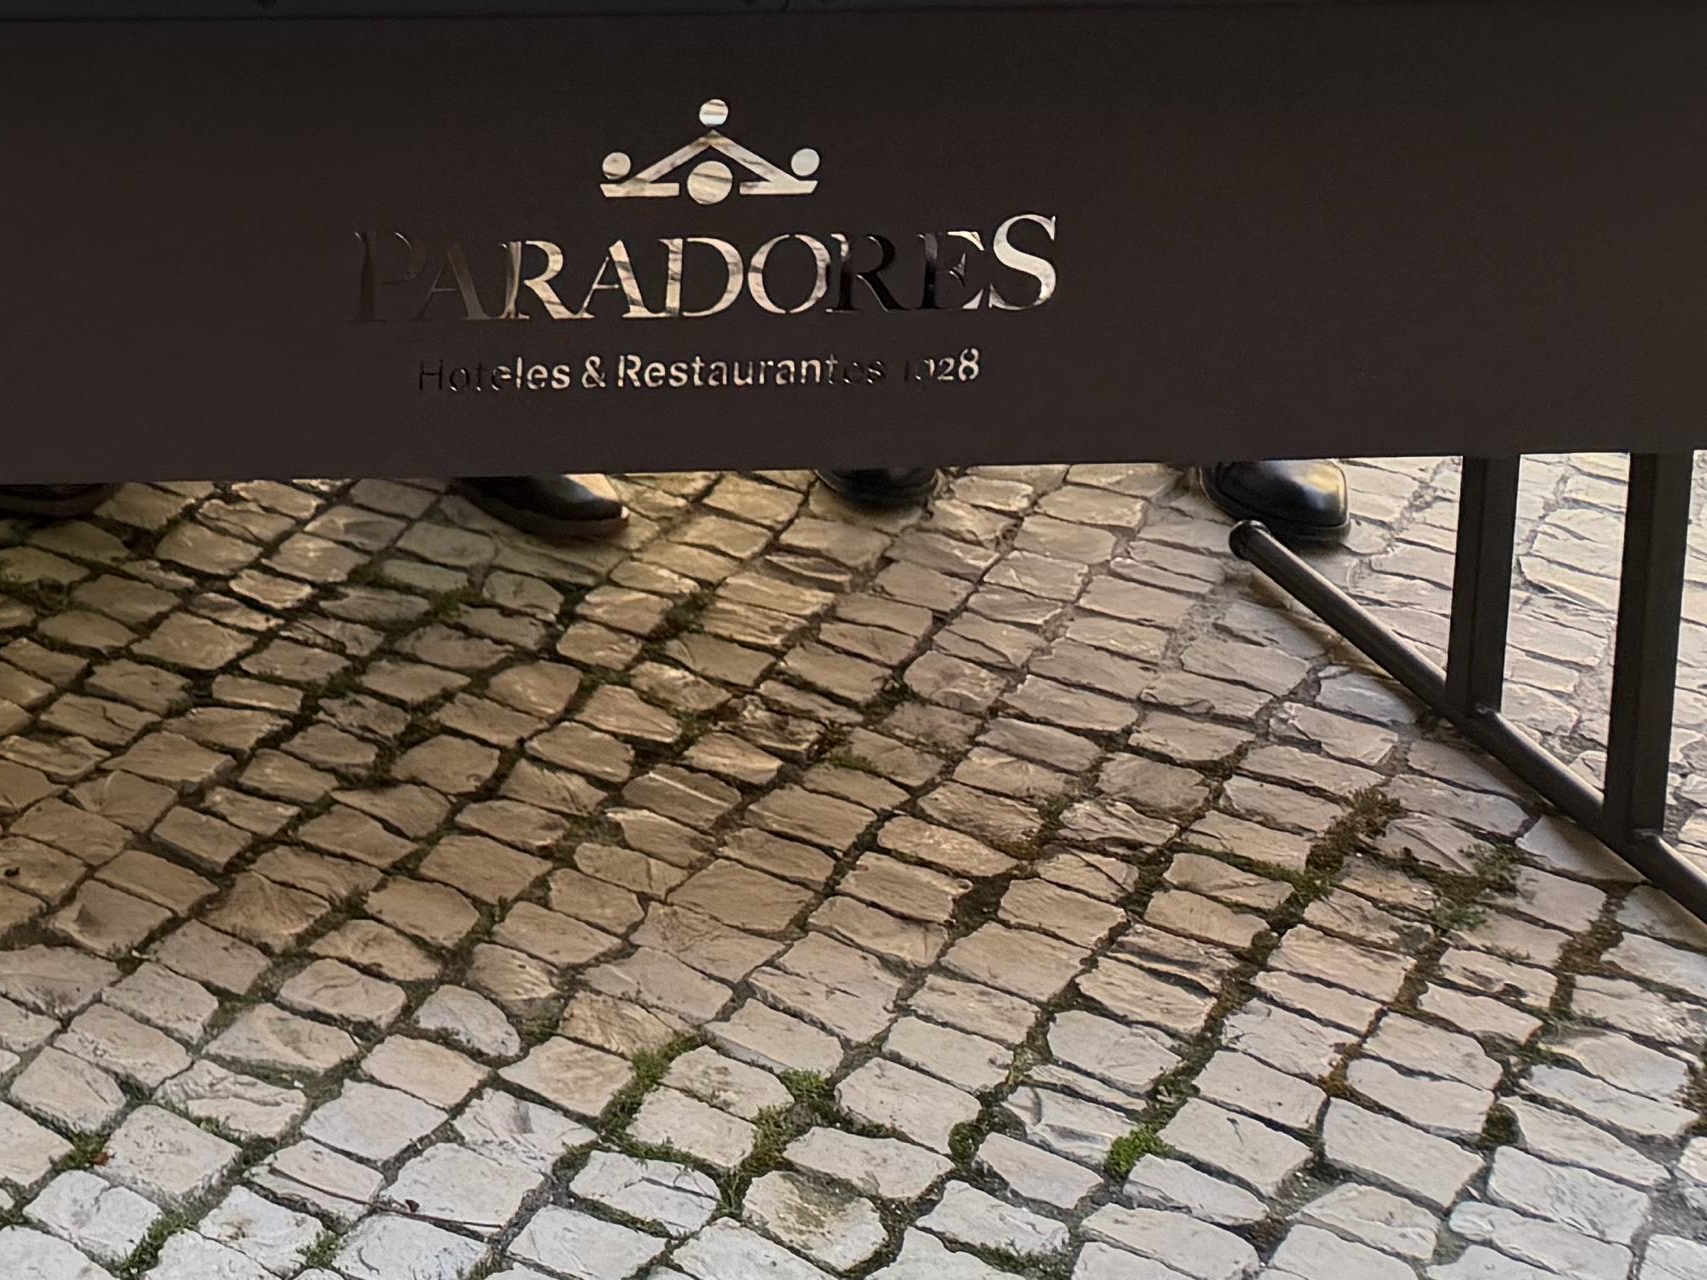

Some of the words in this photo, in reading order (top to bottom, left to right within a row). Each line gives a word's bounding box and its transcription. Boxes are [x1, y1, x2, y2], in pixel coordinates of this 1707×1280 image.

[351, 214, 1058, 322] PARADORES
[419, 356, 573, 393] Hoteles
[581, 354, 607, 390] &
